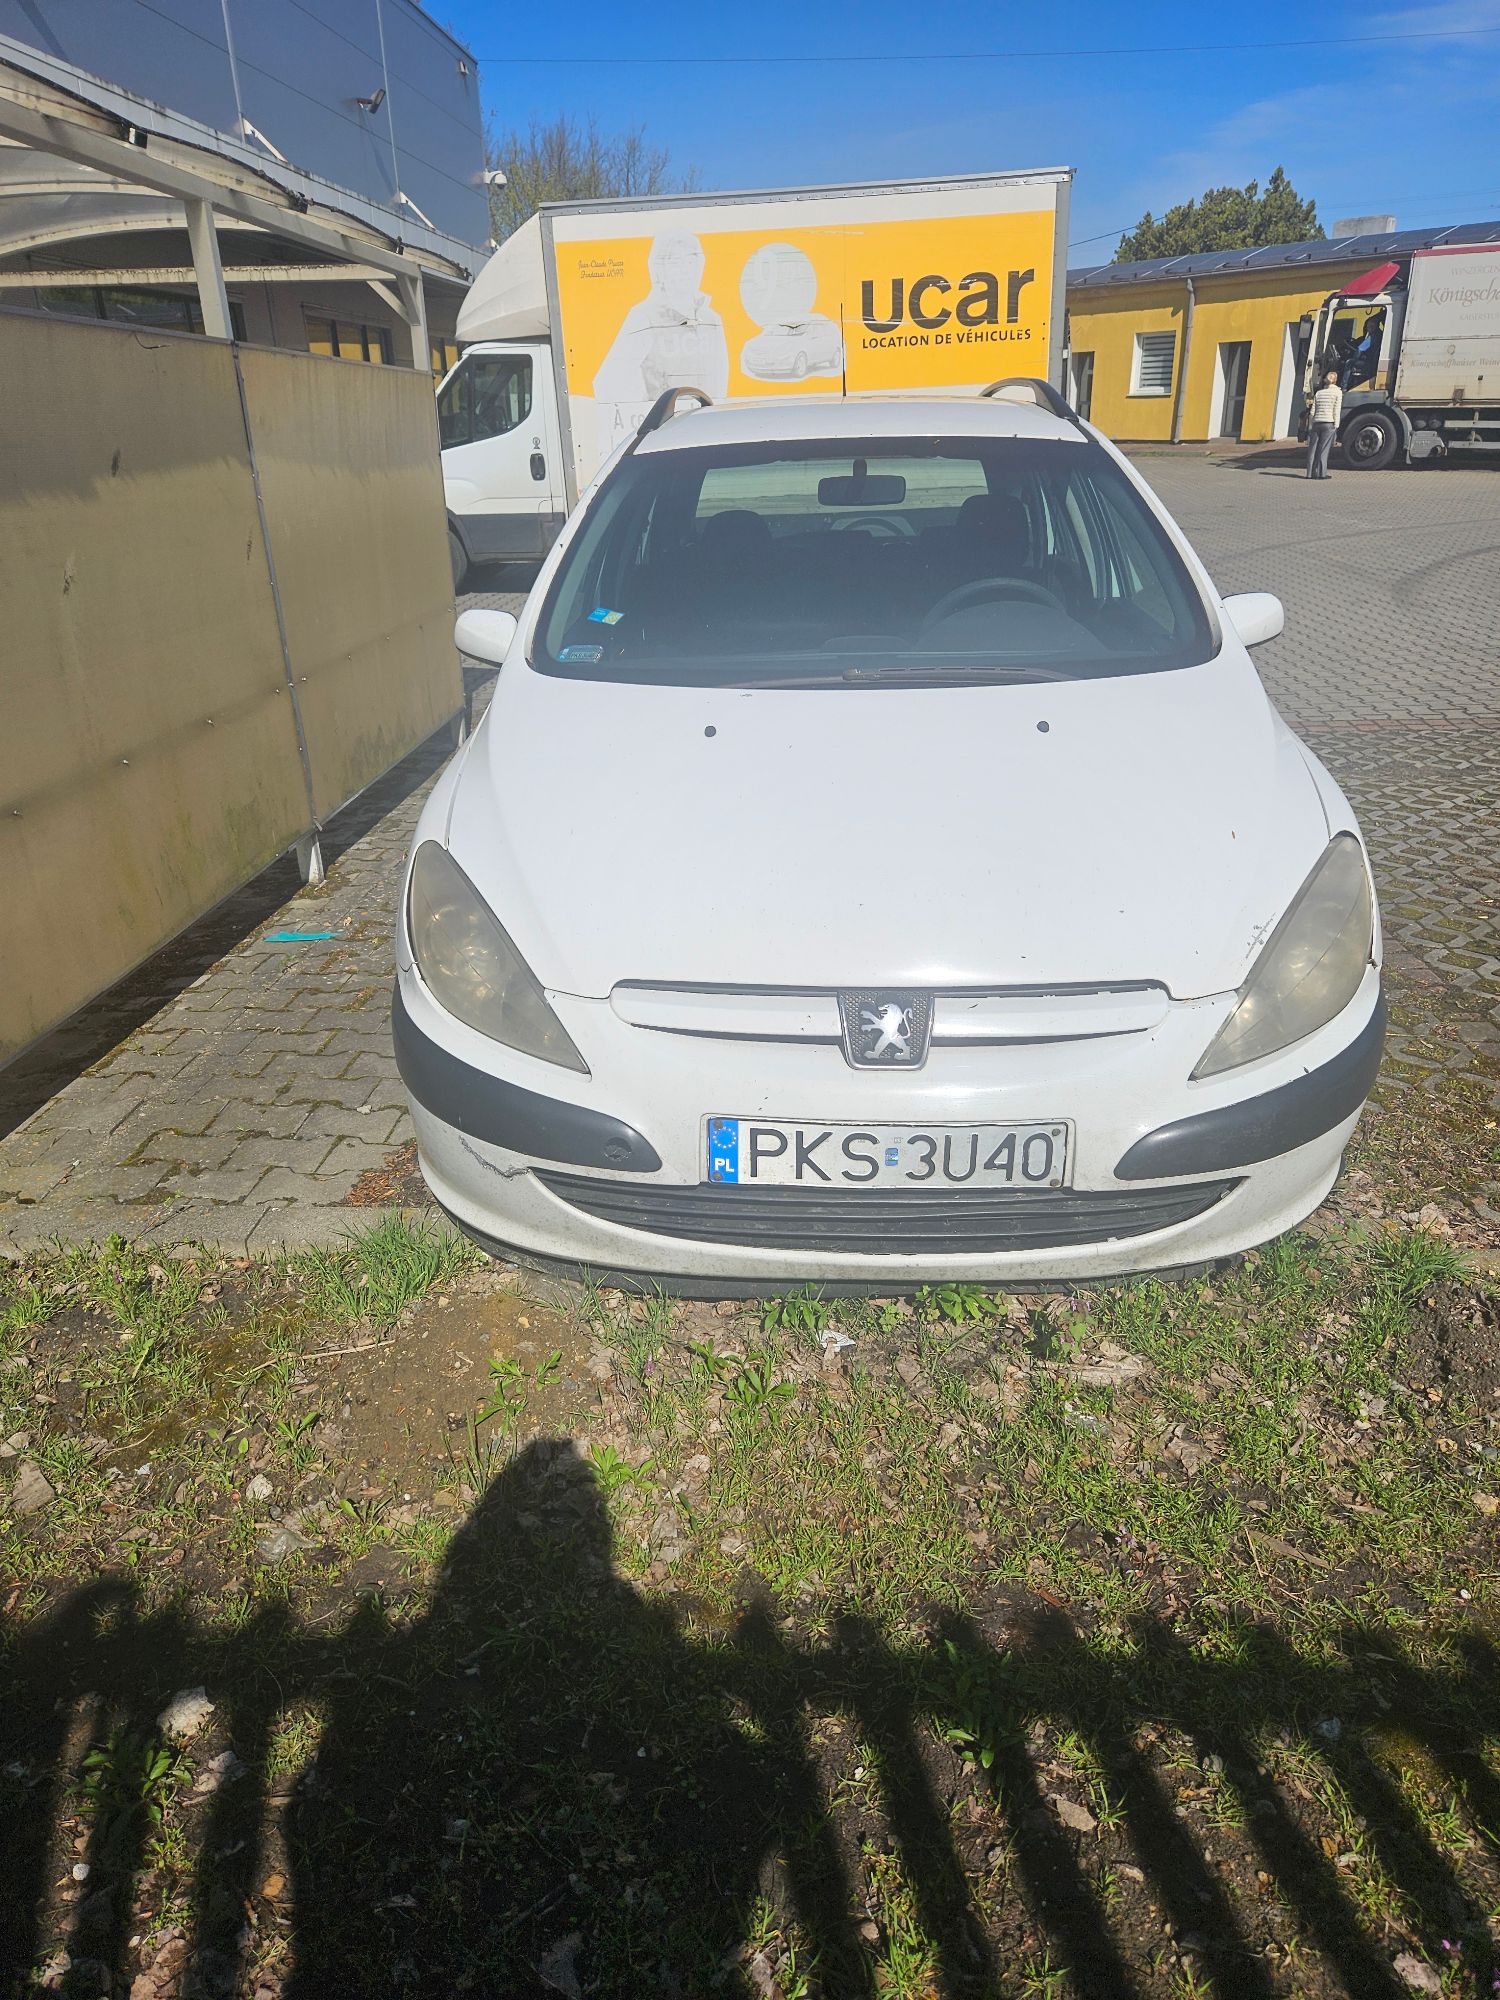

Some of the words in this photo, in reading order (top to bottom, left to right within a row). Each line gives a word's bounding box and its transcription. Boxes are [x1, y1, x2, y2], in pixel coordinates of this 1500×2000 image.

[861, 268, 1035, 334] ucar
[862, 334, 930, 350] LOCATION
[934, 333, 952, 345] DE
[956, 328, 1032, 344] VÉHICULES
[713, 1157, 735, 1174] PL
[749, 1127, 881, 1182] PKS
[905, 1131, 1055, 1182] 3U40
